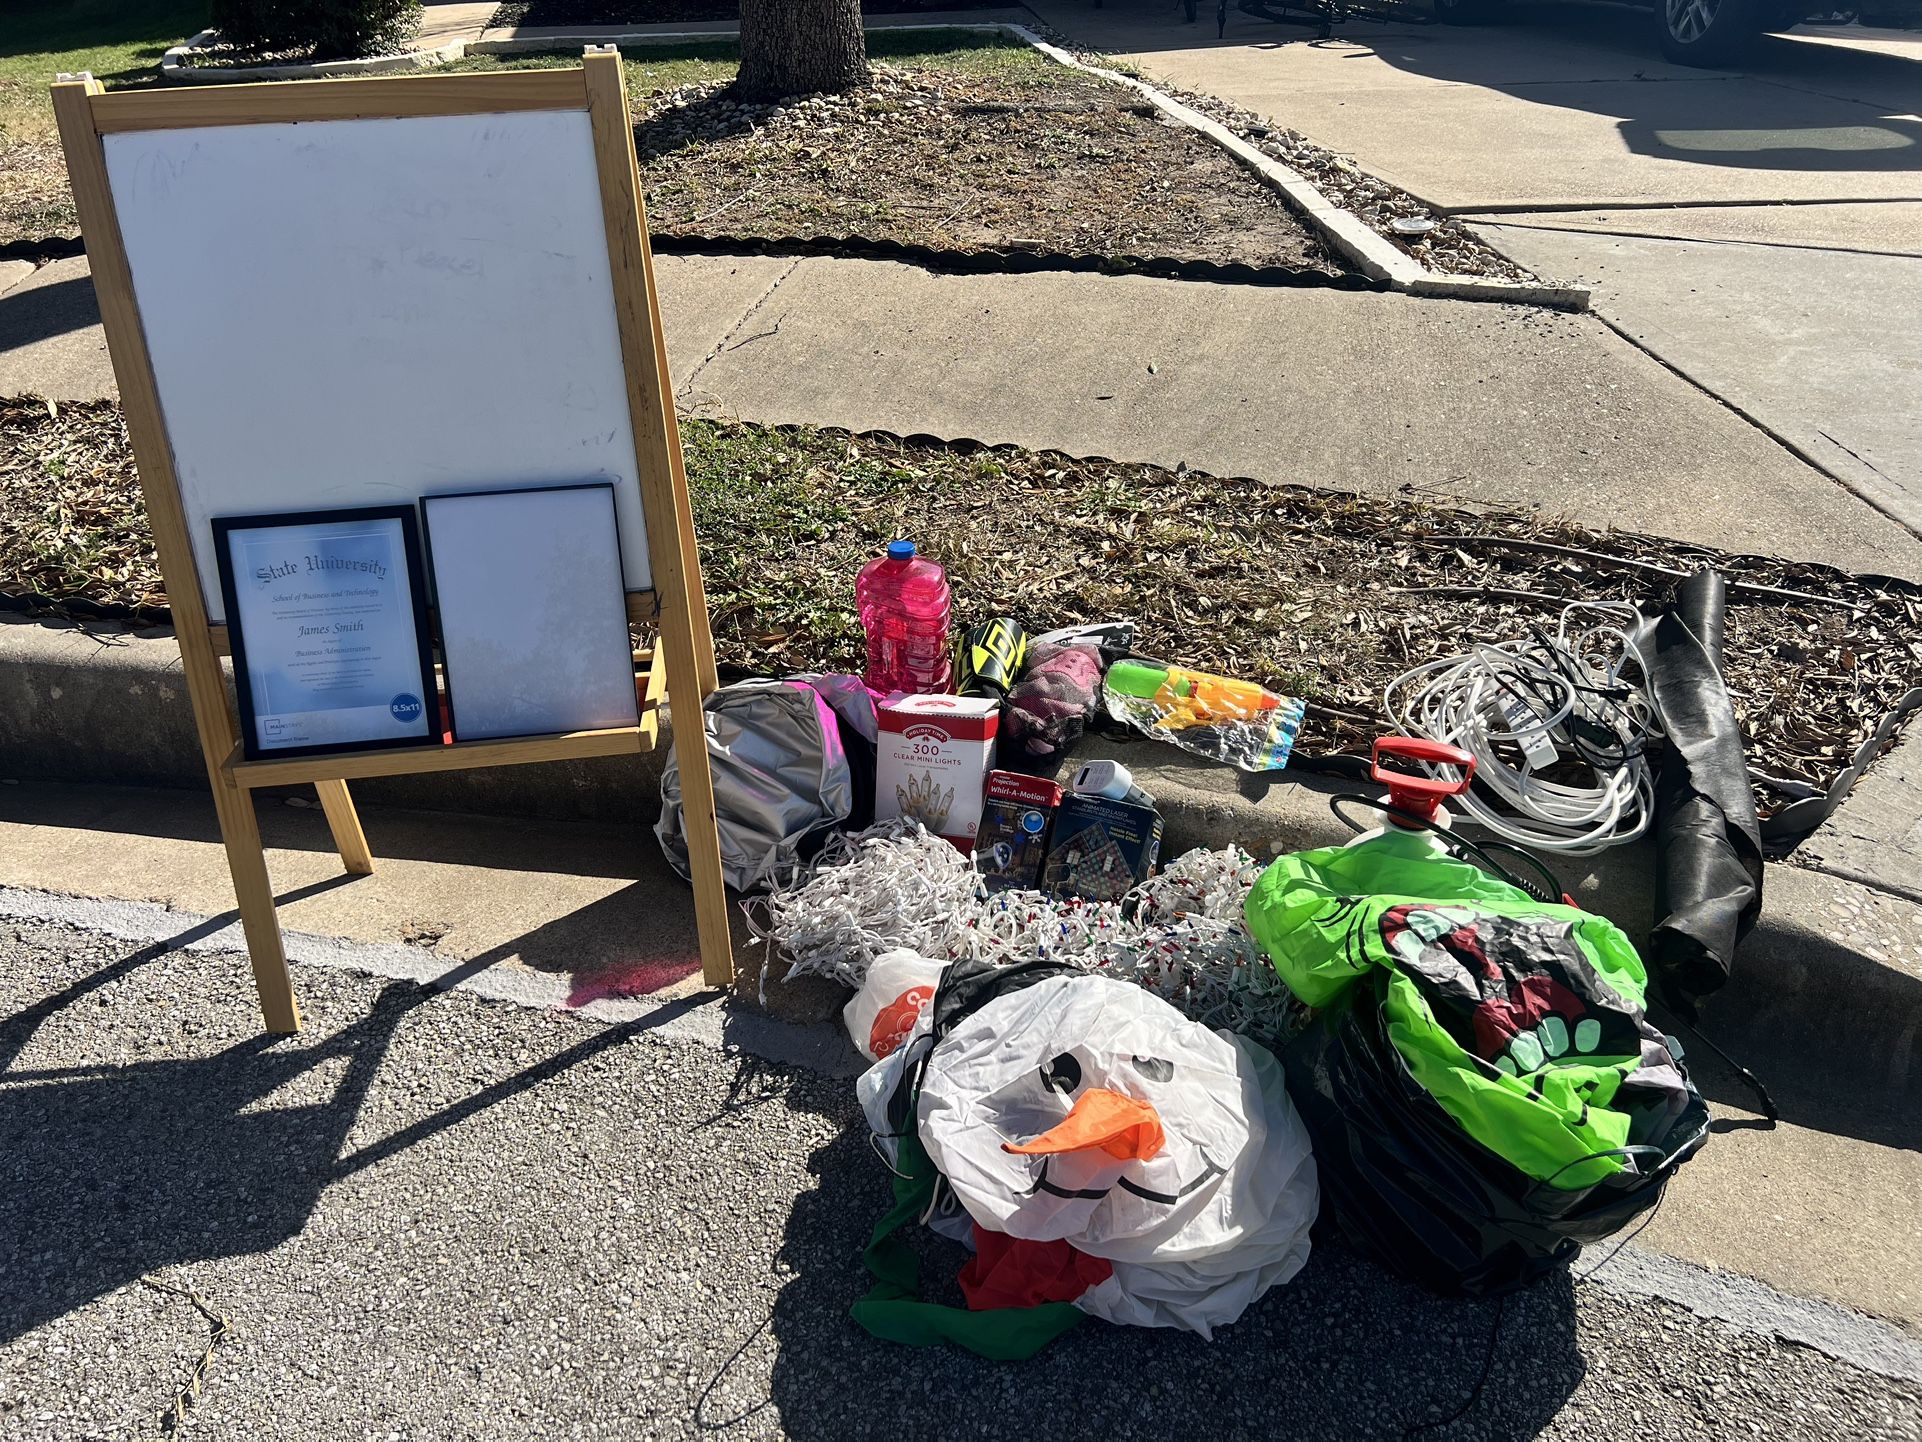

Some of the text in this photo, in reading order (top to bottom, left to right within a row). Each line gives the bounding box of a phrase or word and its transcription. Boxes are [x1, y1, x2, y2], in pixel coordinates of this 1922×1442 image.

[256, 555, 386, 584] State University
[272, 587, 379, 603] School of Business and Technology
[297, 619, 364, 638] James Smith
[294, 646, 371, 658] Business Administration
[392, 702, 420, 713] 8.5x11
[908, 728, 945, 739] HOLIDAY TIME
[913, 743, 940, 756] 300
[893, 752, 915, 761] CLEAR
[916, 755, 933, 763] MINI
[935, 758, 962, 766] LIGHTS
[992, 777, 1020, 787] Projection
